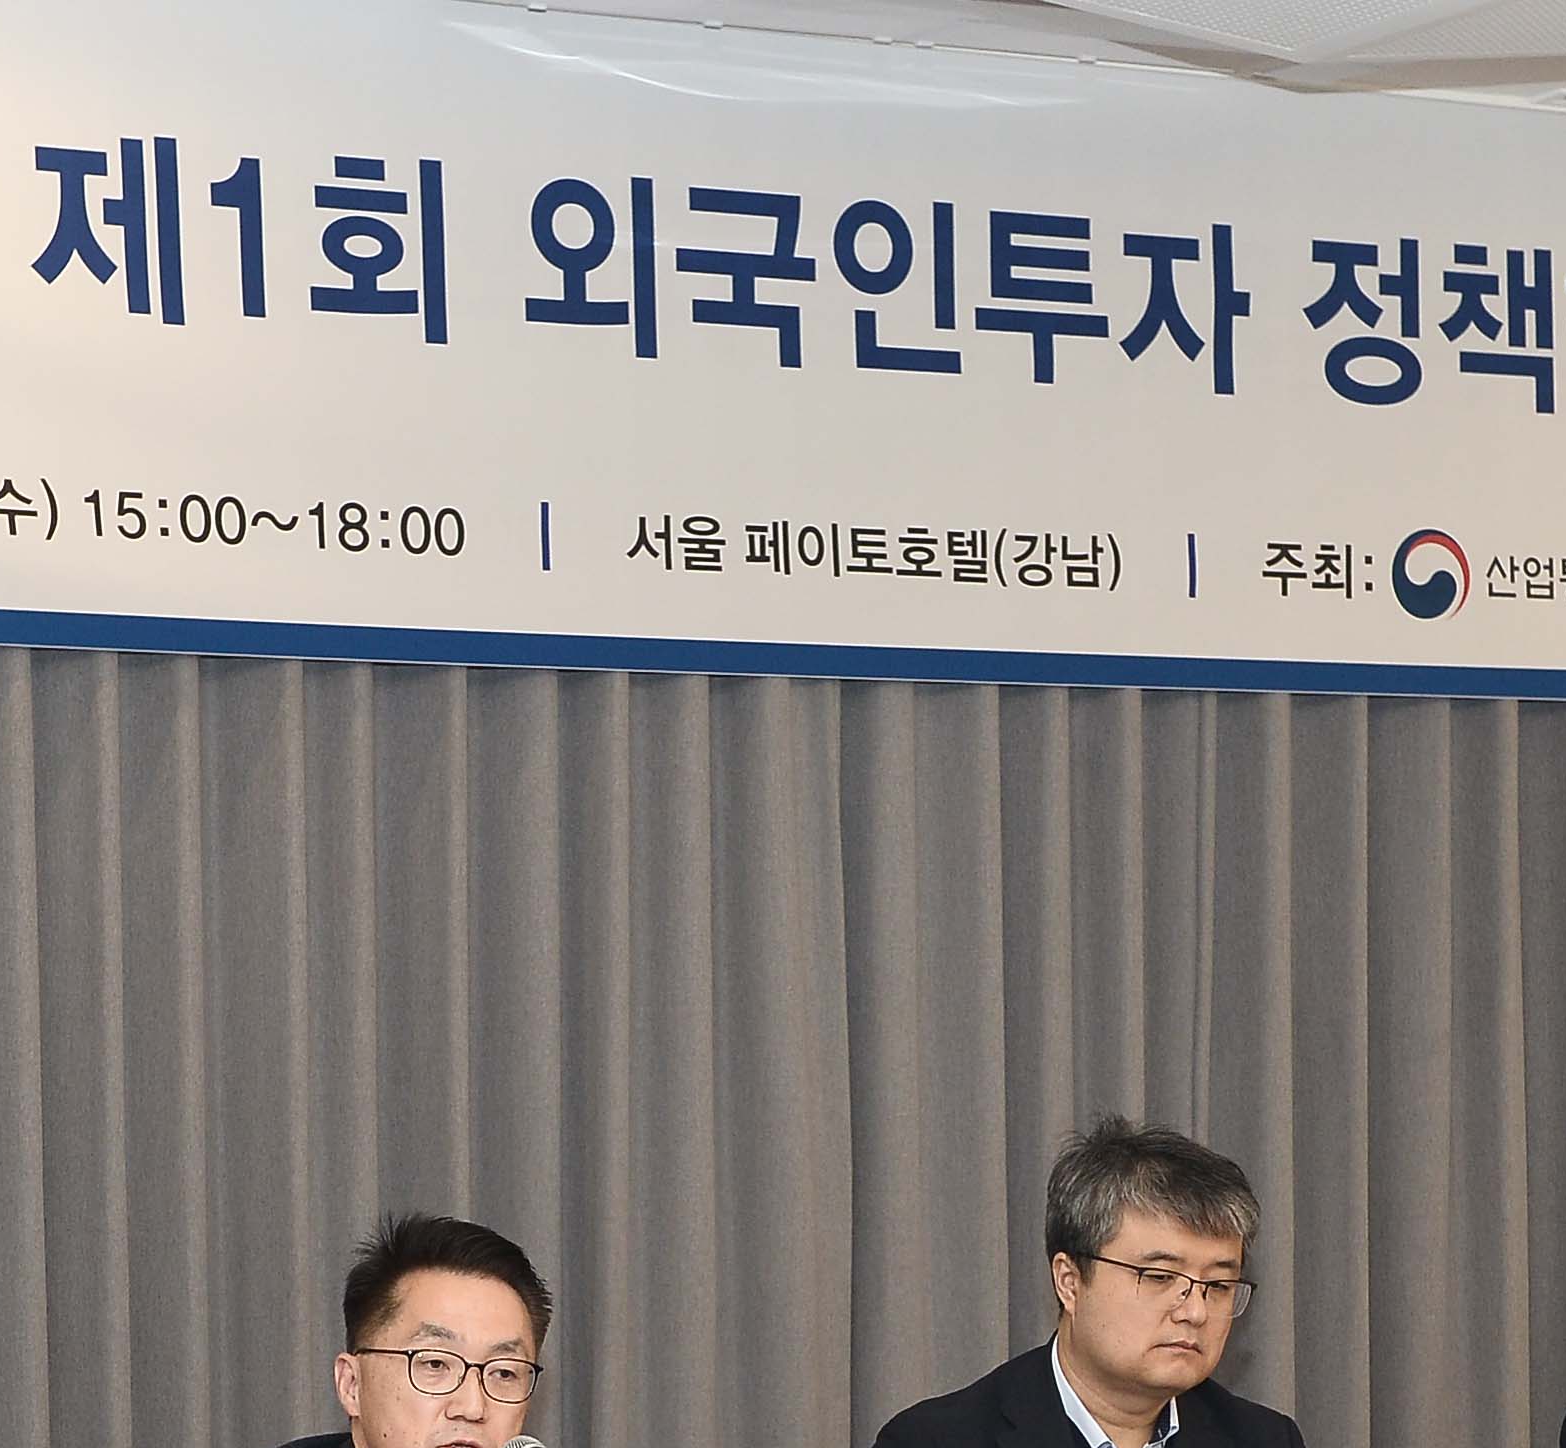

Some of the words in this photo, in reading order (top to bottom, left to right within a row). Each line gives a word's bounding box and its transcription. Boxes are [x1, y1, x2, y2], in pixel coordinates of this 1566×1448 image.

[31, 136, 449, 346] 제1회
[524, 176, 1251, 396] 외국인투자
[84, 489, 466, 557] 15:00~18:00
[626, 514, 726, 573] 서울
[745, 520, 1122, 592] 페이토호텔(강남)
[1261, 542, 1375, 599] 주최:
